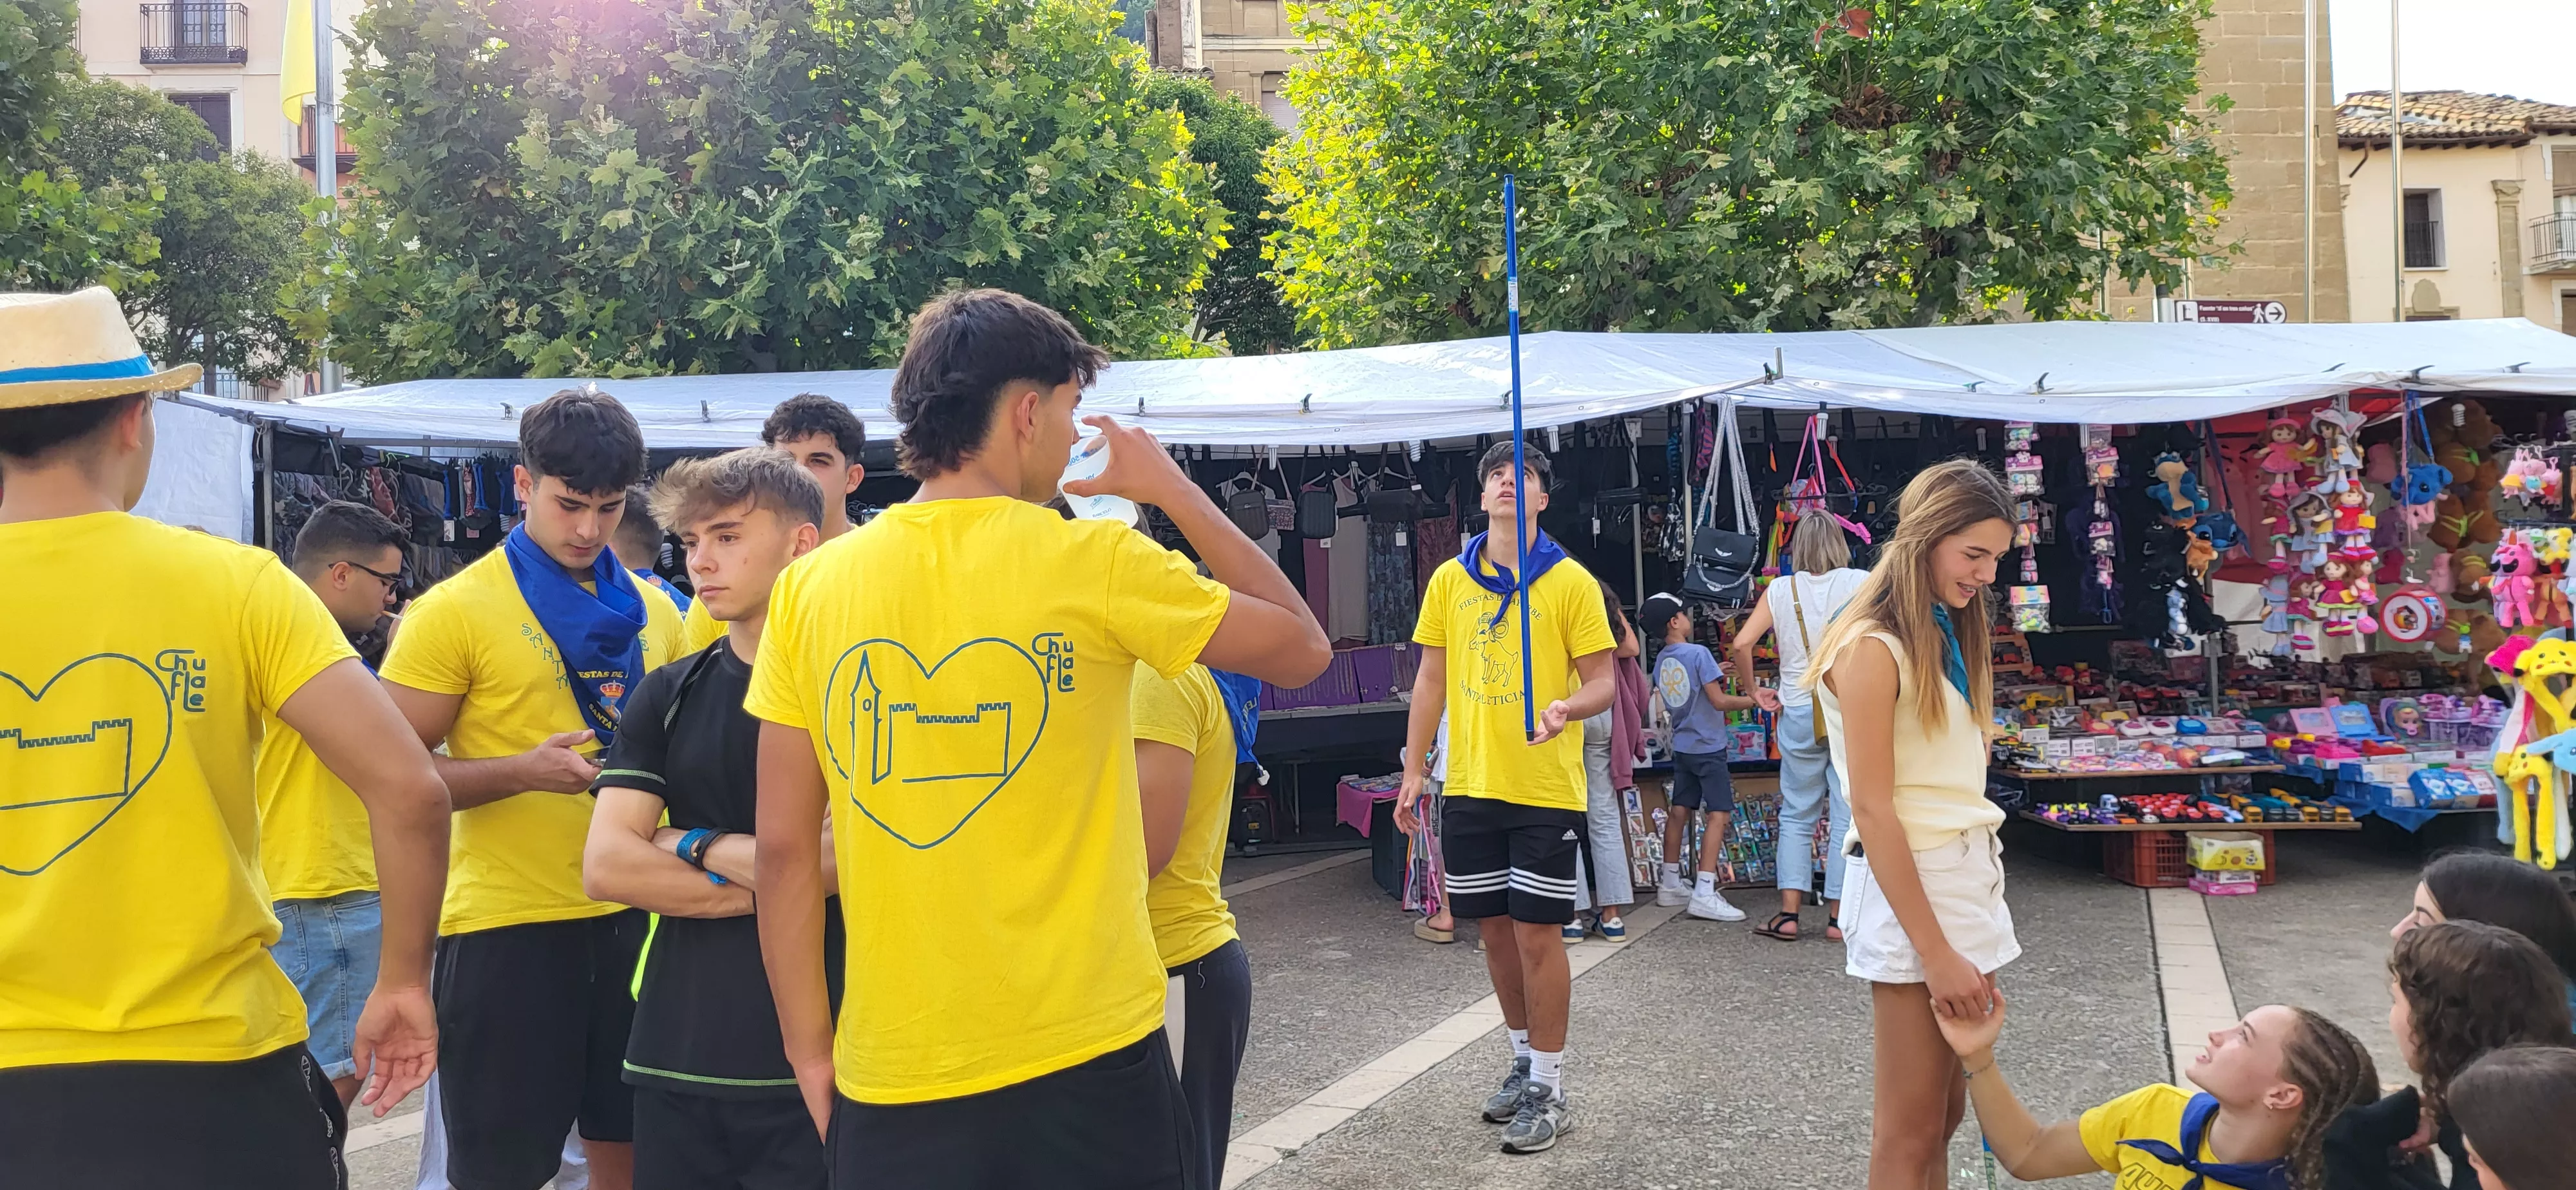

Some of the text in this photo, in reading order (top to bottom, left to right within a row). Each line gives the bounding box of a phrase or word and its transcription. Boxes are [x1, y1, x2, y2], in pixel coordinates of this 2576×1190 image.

[1459, 594, 1494, 610] FIESTAS
[521, 623, 569, 690] SANTA
[577, 670, 610, 679] ESTAS
[589, 703, 612, 728] SANTA
